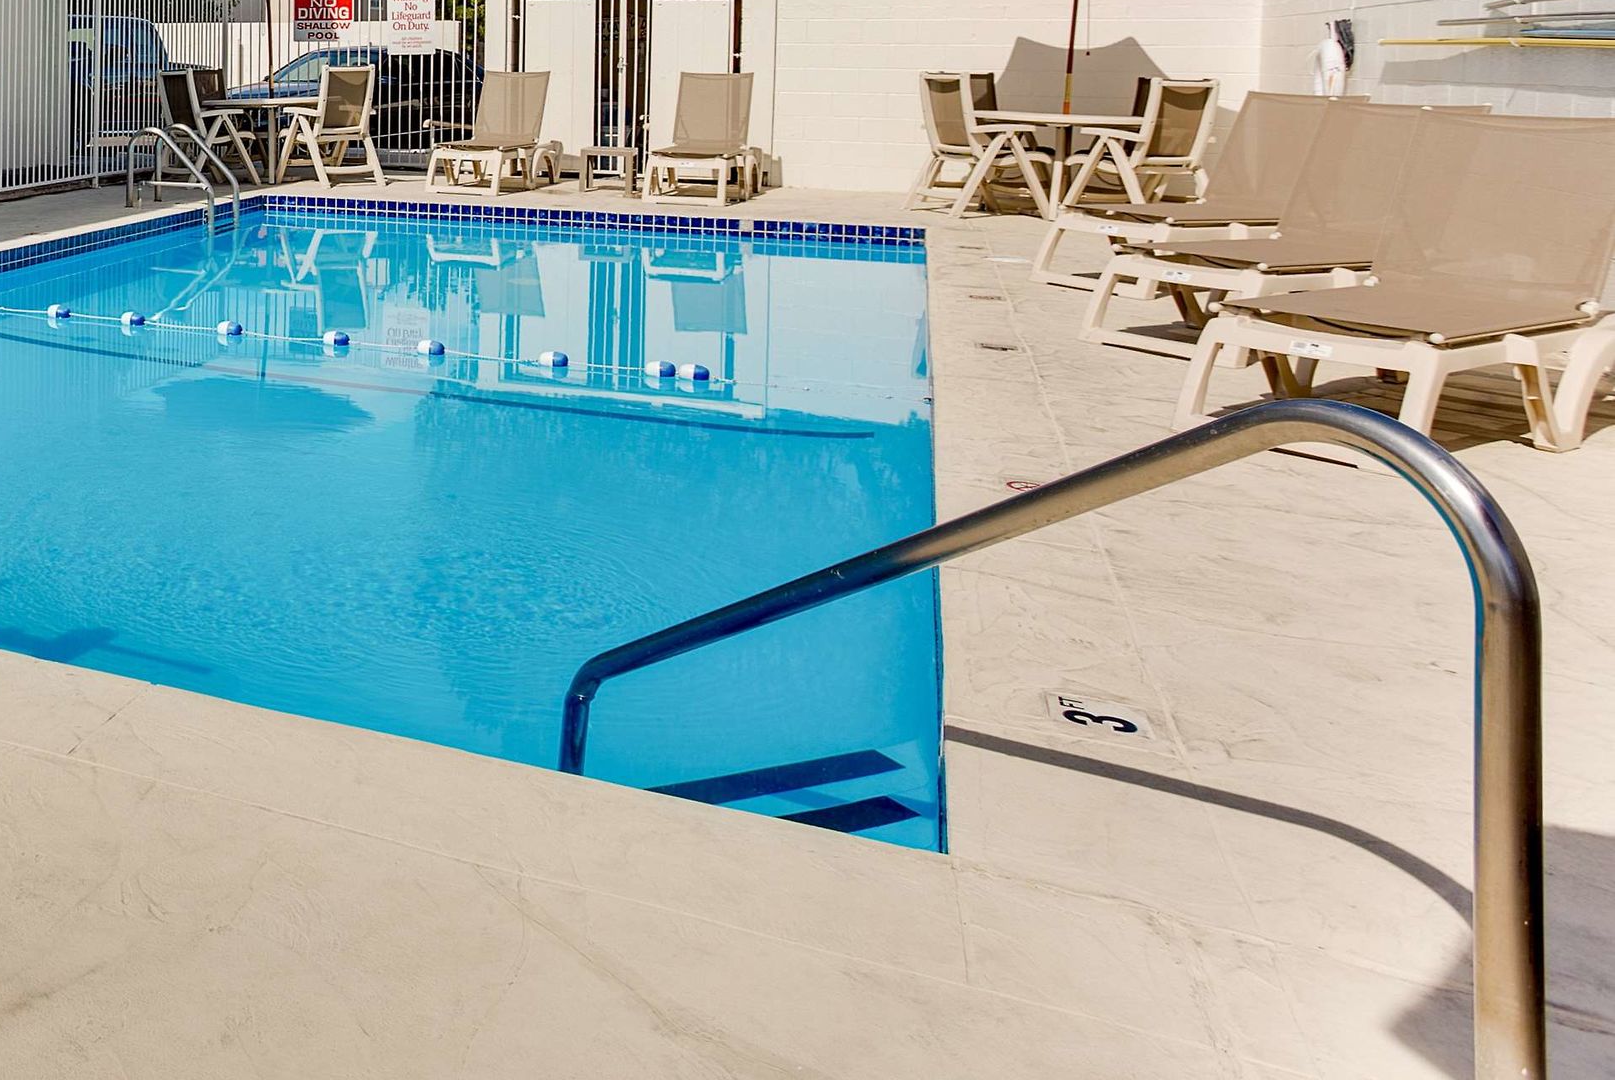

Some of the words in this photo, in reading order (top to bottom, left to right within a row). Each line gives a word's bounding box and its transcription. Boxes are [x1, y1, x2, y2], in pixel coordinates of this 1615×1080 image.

[404, 2, 418, 11] No
[297, 7, 350, 20] DIVING
[391, 11, 431, 22] Lifeguard
[296, 22, 351, 30] SHALLOW
[392, 22, 407, 31] On
[307, 32, 340, 40] POOL
[1058, 696, 1085, 710] FT
[1063, 709, 1138, 733] 3
